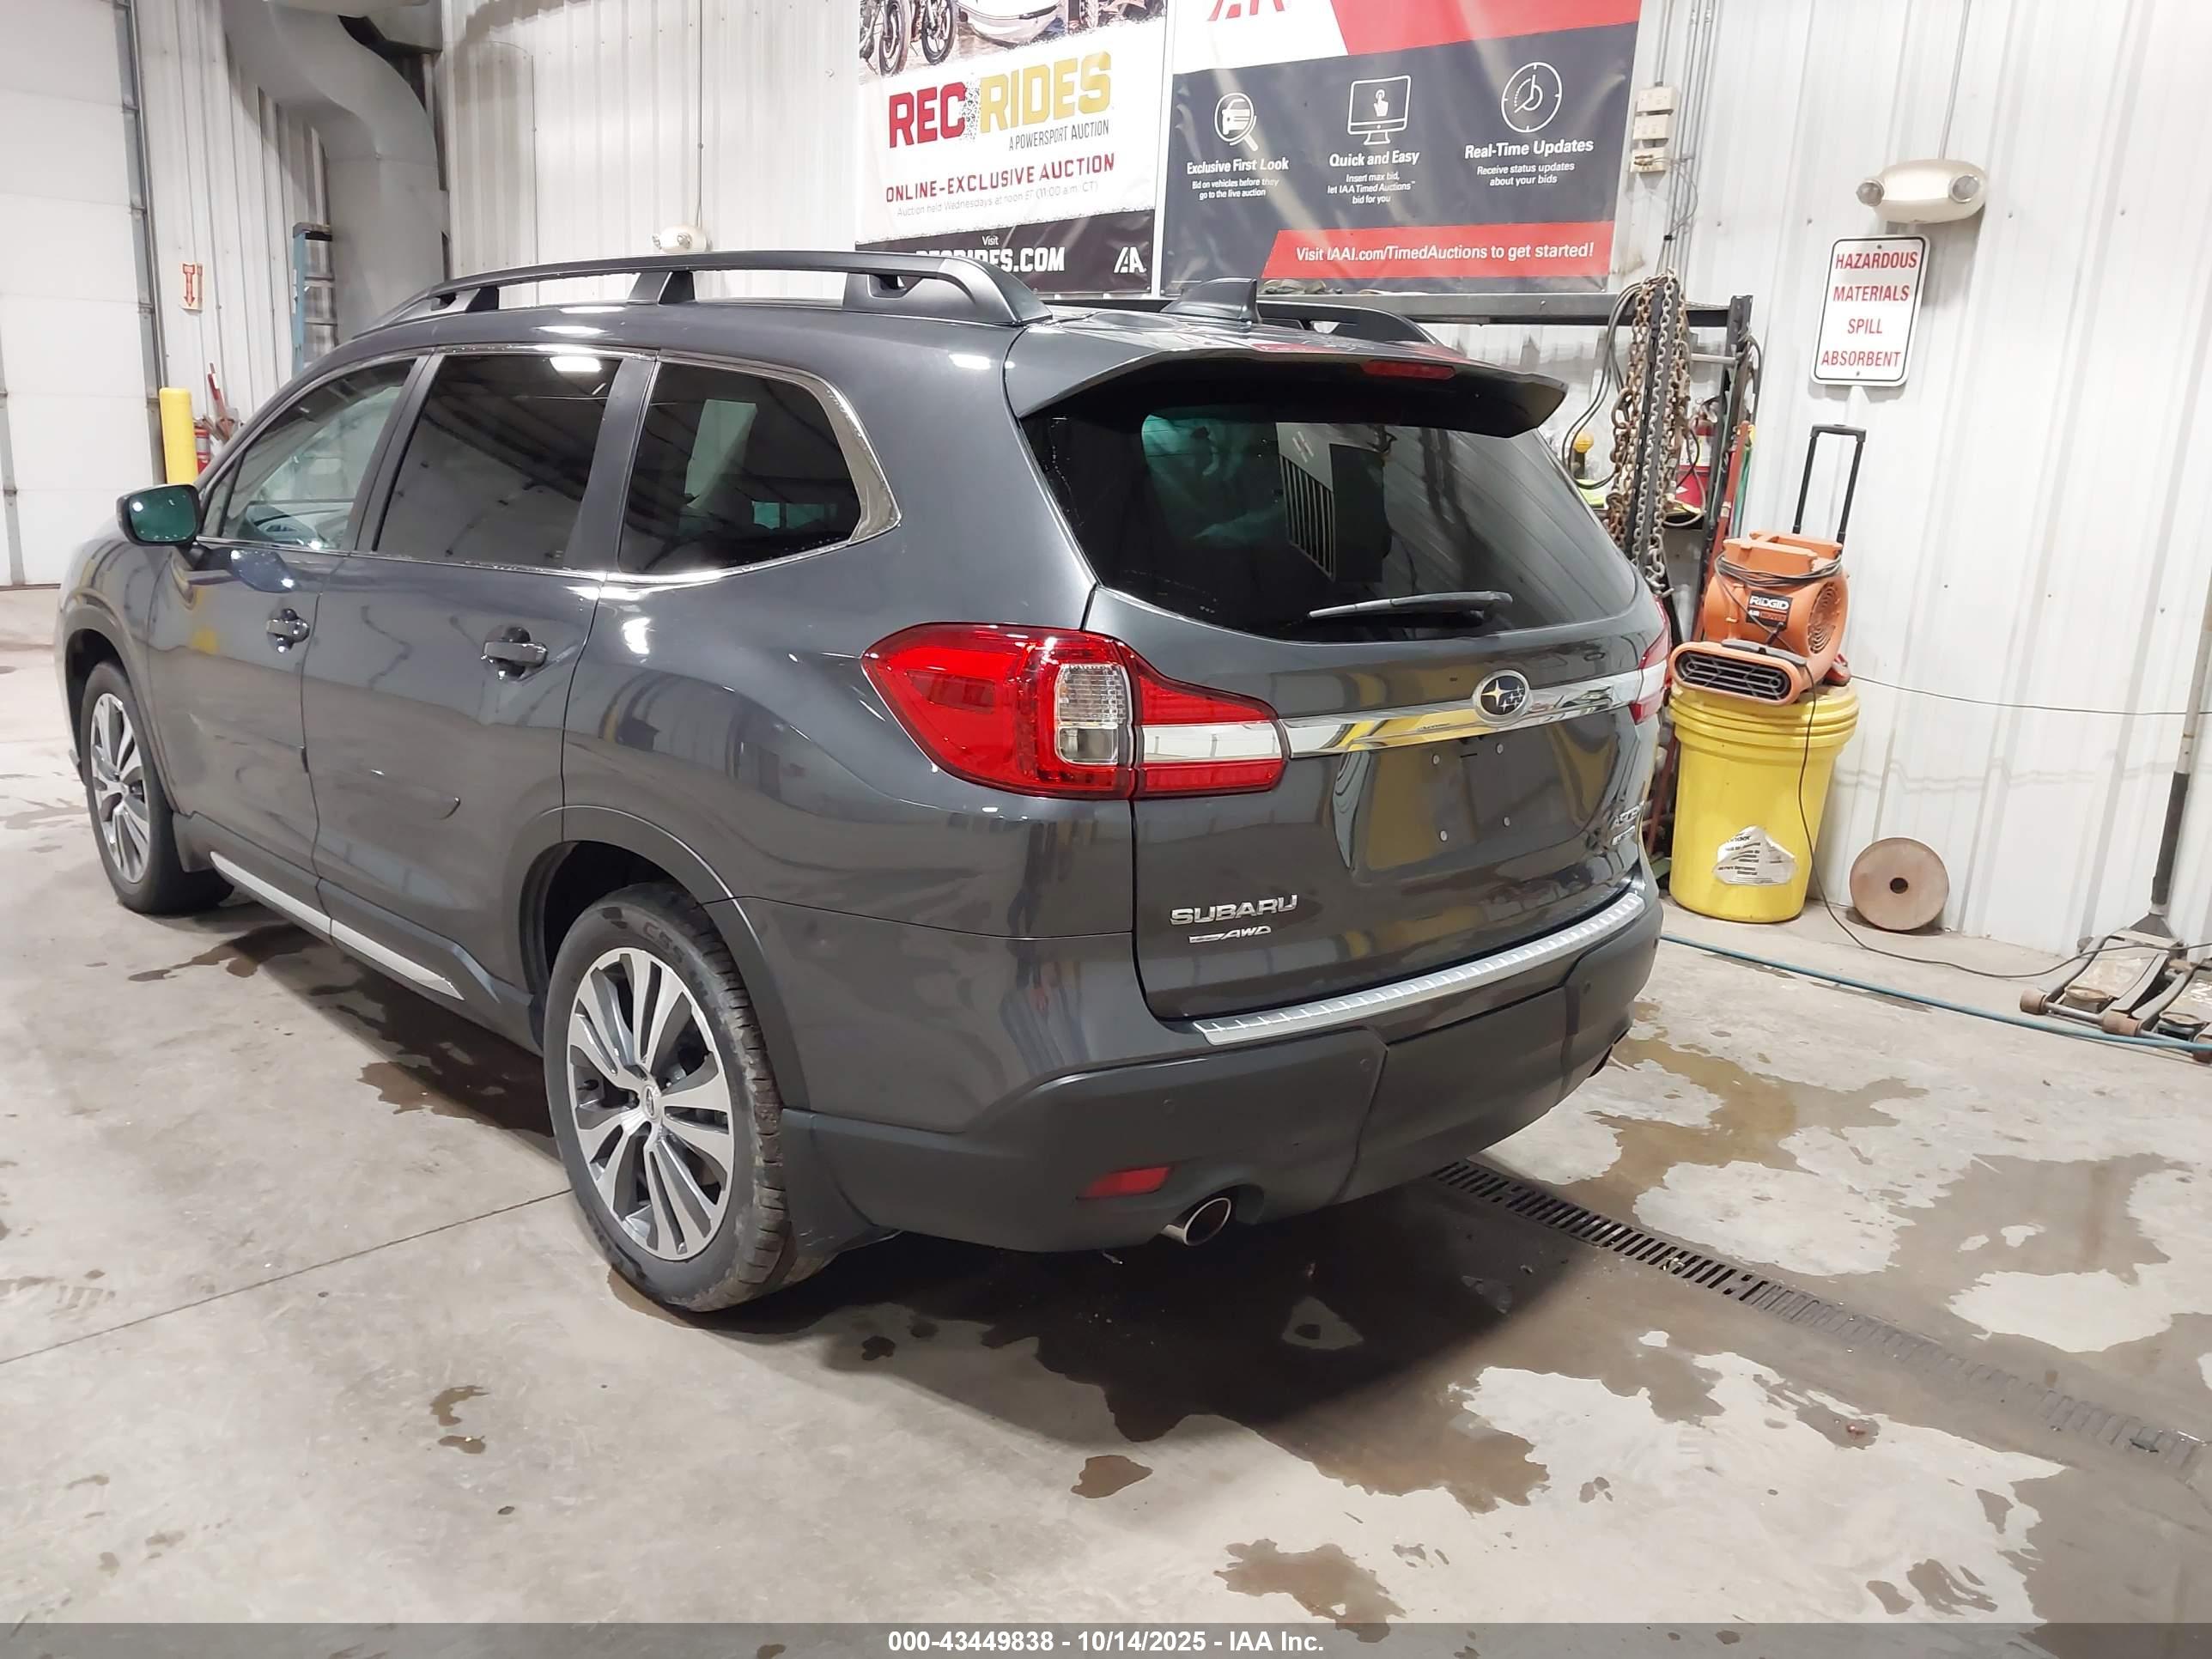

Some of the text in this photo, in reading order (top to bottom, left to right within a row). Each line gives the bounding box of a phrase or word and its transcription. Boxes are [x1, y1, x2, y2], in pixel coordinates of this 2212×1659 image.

[889, 51, 1112, 149] REC RIDES
[1009, 118, 1109, 151] A POWERSPORT AUCTION
[1464, 138, 1595, 160] Real-Time Updates
[1187, 156, 1290, 175] Exclusive First Look
[1328, 149, 1420, 167] Quick and Easy
[1346, 171, 1401, 183] Insert max bid,
[1477, 161, 1576, 176] Receive status updates
[885, 153, 1115, 204] ONLINE-EXCLUSIVE AUCTION
[1192, 180, 1202, 190] Bid
[1211, 179, 1238, 188] vehicles
[1238, 178, 1261, 187] before
[1261, 178, 1280, 186] they
[1489, 173, 1559, 187] about your bids
[1199, 187, 1267, 201] go to the live auction
[1327, 185, 1338, 194] let
[1339, 184, 1356, 193] IAA
[1356, 183, 1379, 193] Timed
[1352, 194, 1392, 205] bid for you
[896, 204, 926, 217] Auction
[981, 234, 1000, 246] Visit
[1296, 241, 1595, 262] Visit IAAI.com/TimedAuctions to get started!
[1834, 251, 1919, 270] HAZARDOUS
[1832, 284, 1911, 302] MATERIALS
[1846, 318, 1884, 335] SPILL
[1820, 349, 1902, 368] ABSORBENT
[1748, 595, 1790, 611] RIDGID
[1169, 893, 1299, 926] SUBARU
[1220, 924, 1273, 941] AWD
